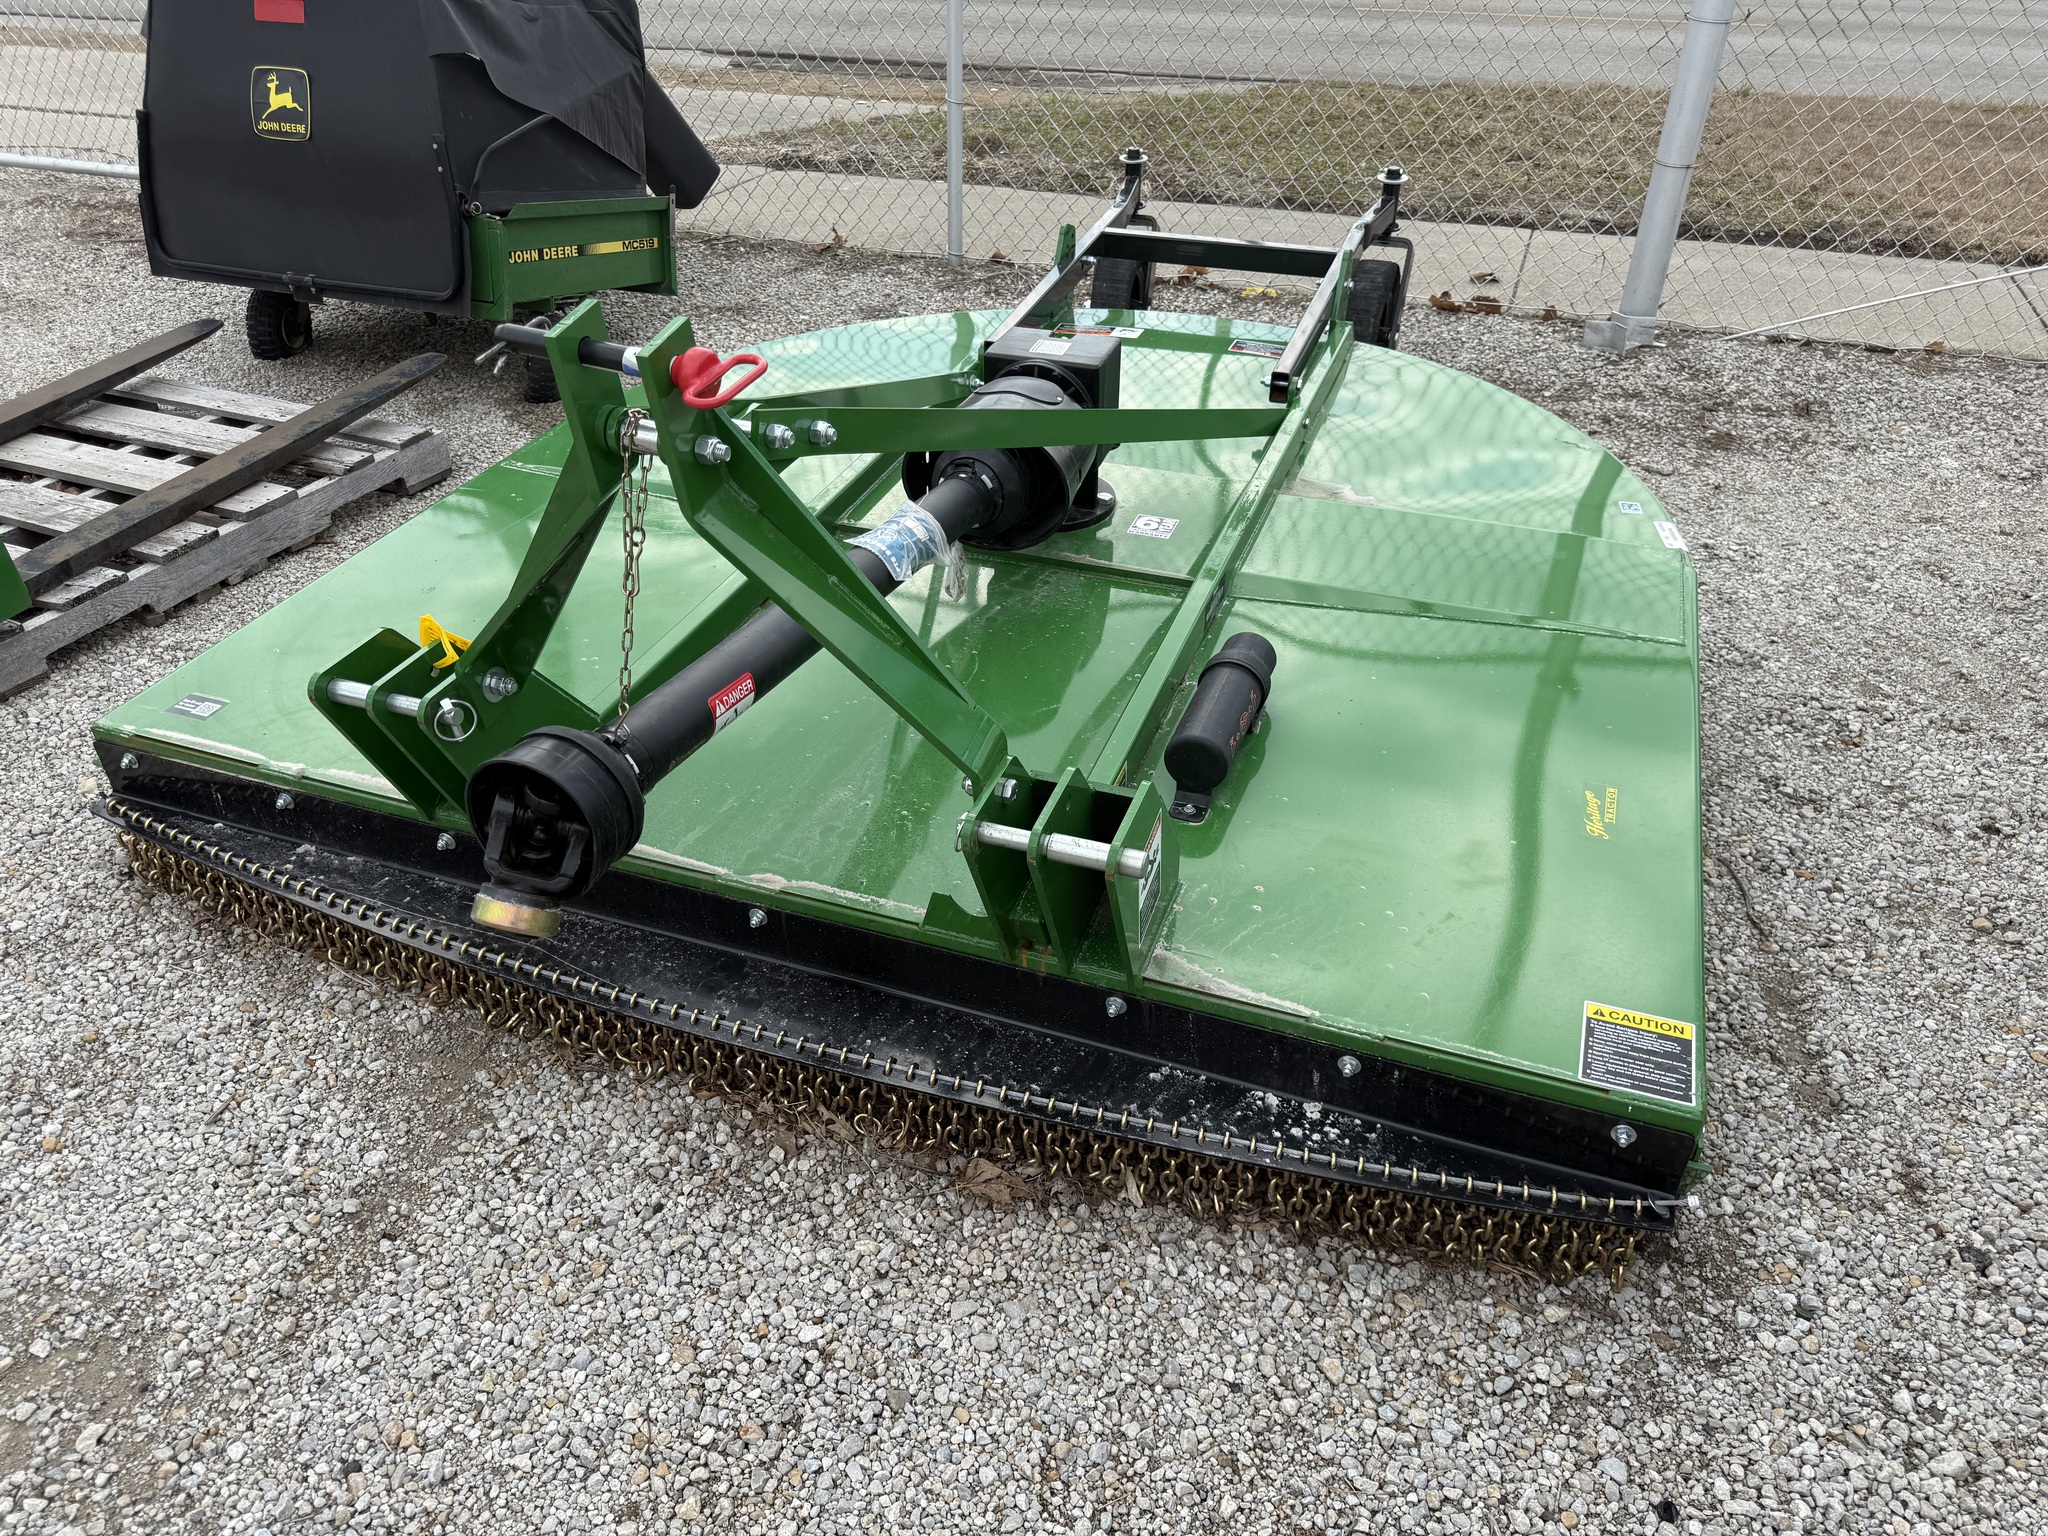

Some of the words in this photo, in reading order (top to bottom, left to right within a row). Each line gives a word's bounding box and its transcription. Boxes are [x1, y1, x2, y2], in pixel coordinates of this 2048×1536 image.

[258, 121, 279, 131] JOHN
[281, 123, 306, 133] DEERE
[509, 249, 539, 264] JOHN
[543, 245, 578, 260] DEERE
[622, 238, 654, 250] MC519
[1135, 515, 1160, 530] 6
[723, 679, 754, 708] DANGER
[1584, 790, 1609, 839] Heritage
[1605, 787, 1617, 823] TRACTOR
[1609, 1011, 1684, 1035] CAUTION
